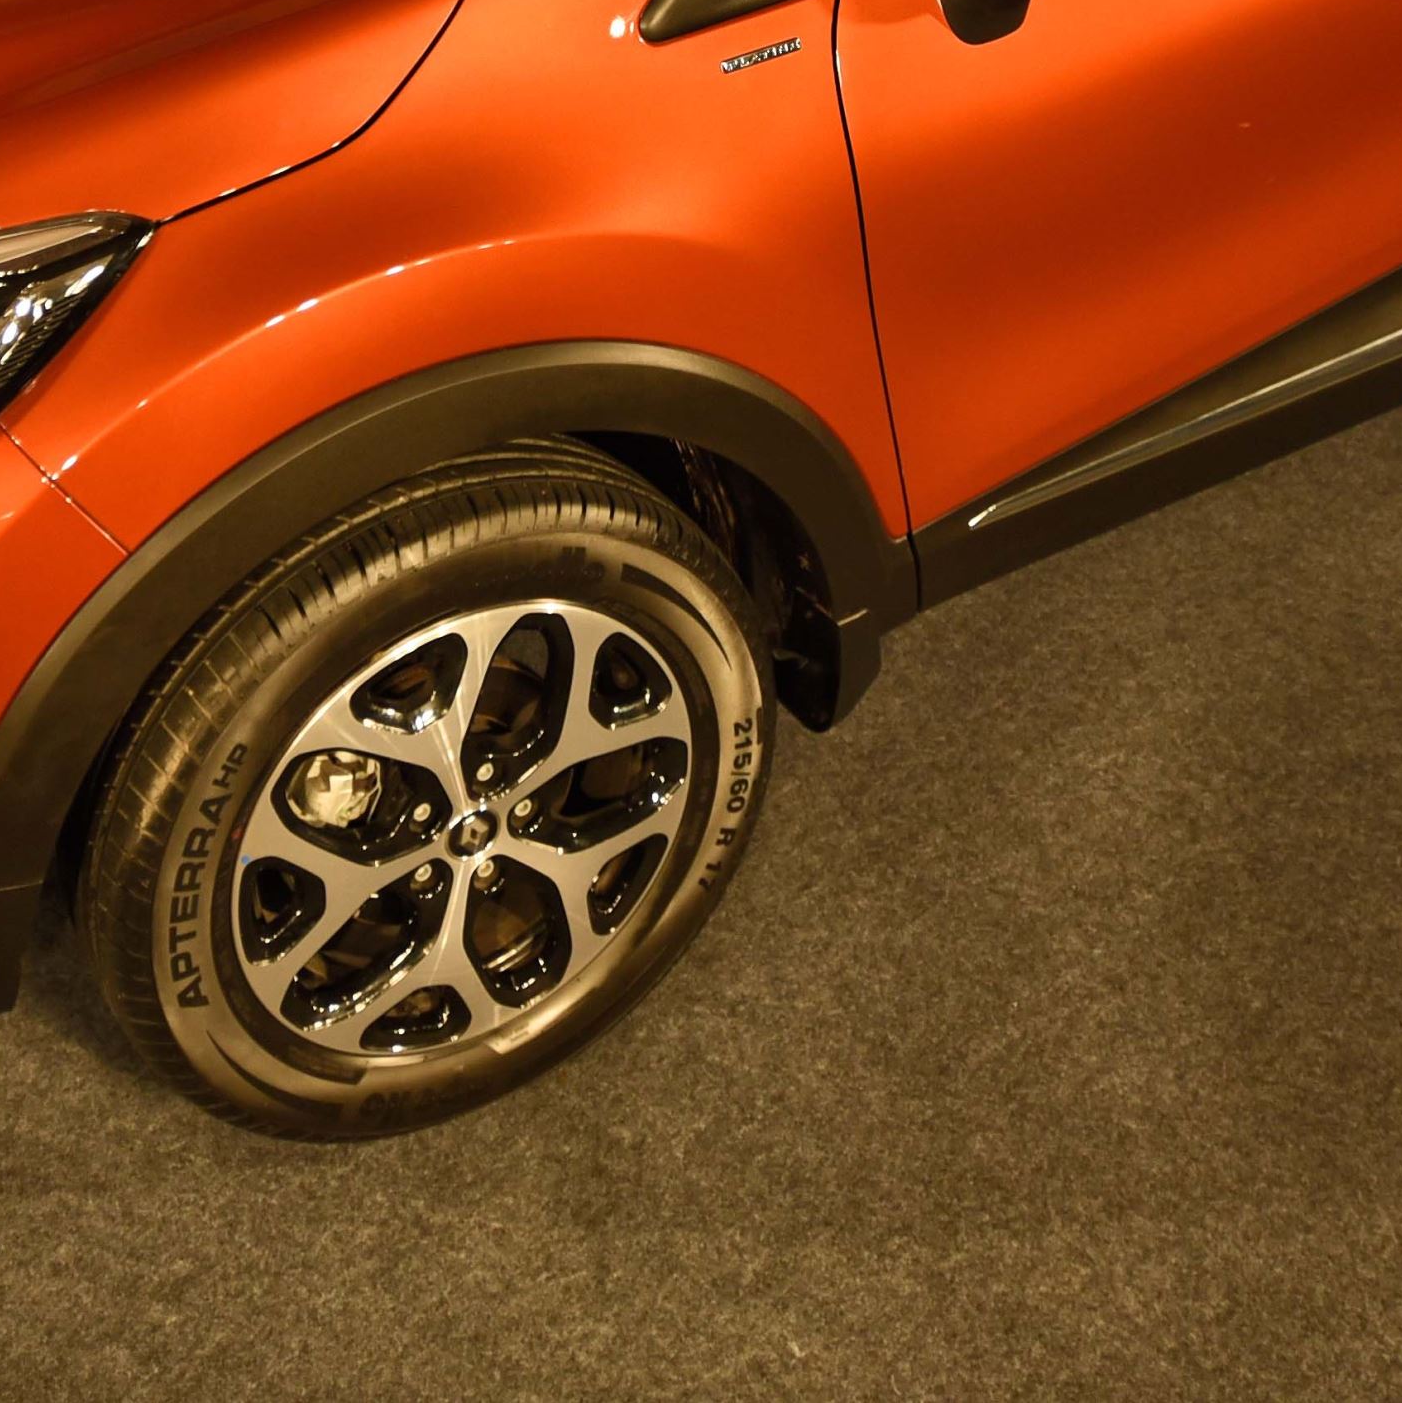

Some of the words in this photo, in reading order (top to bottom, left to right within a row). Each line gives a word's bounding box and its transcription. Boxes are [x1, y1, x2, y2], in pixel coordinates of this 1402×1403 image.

[727, 718, 753, 813] 215/60
[169, 793, 233, 1009] APTERRA
[212, 743, 249, 788] HP
